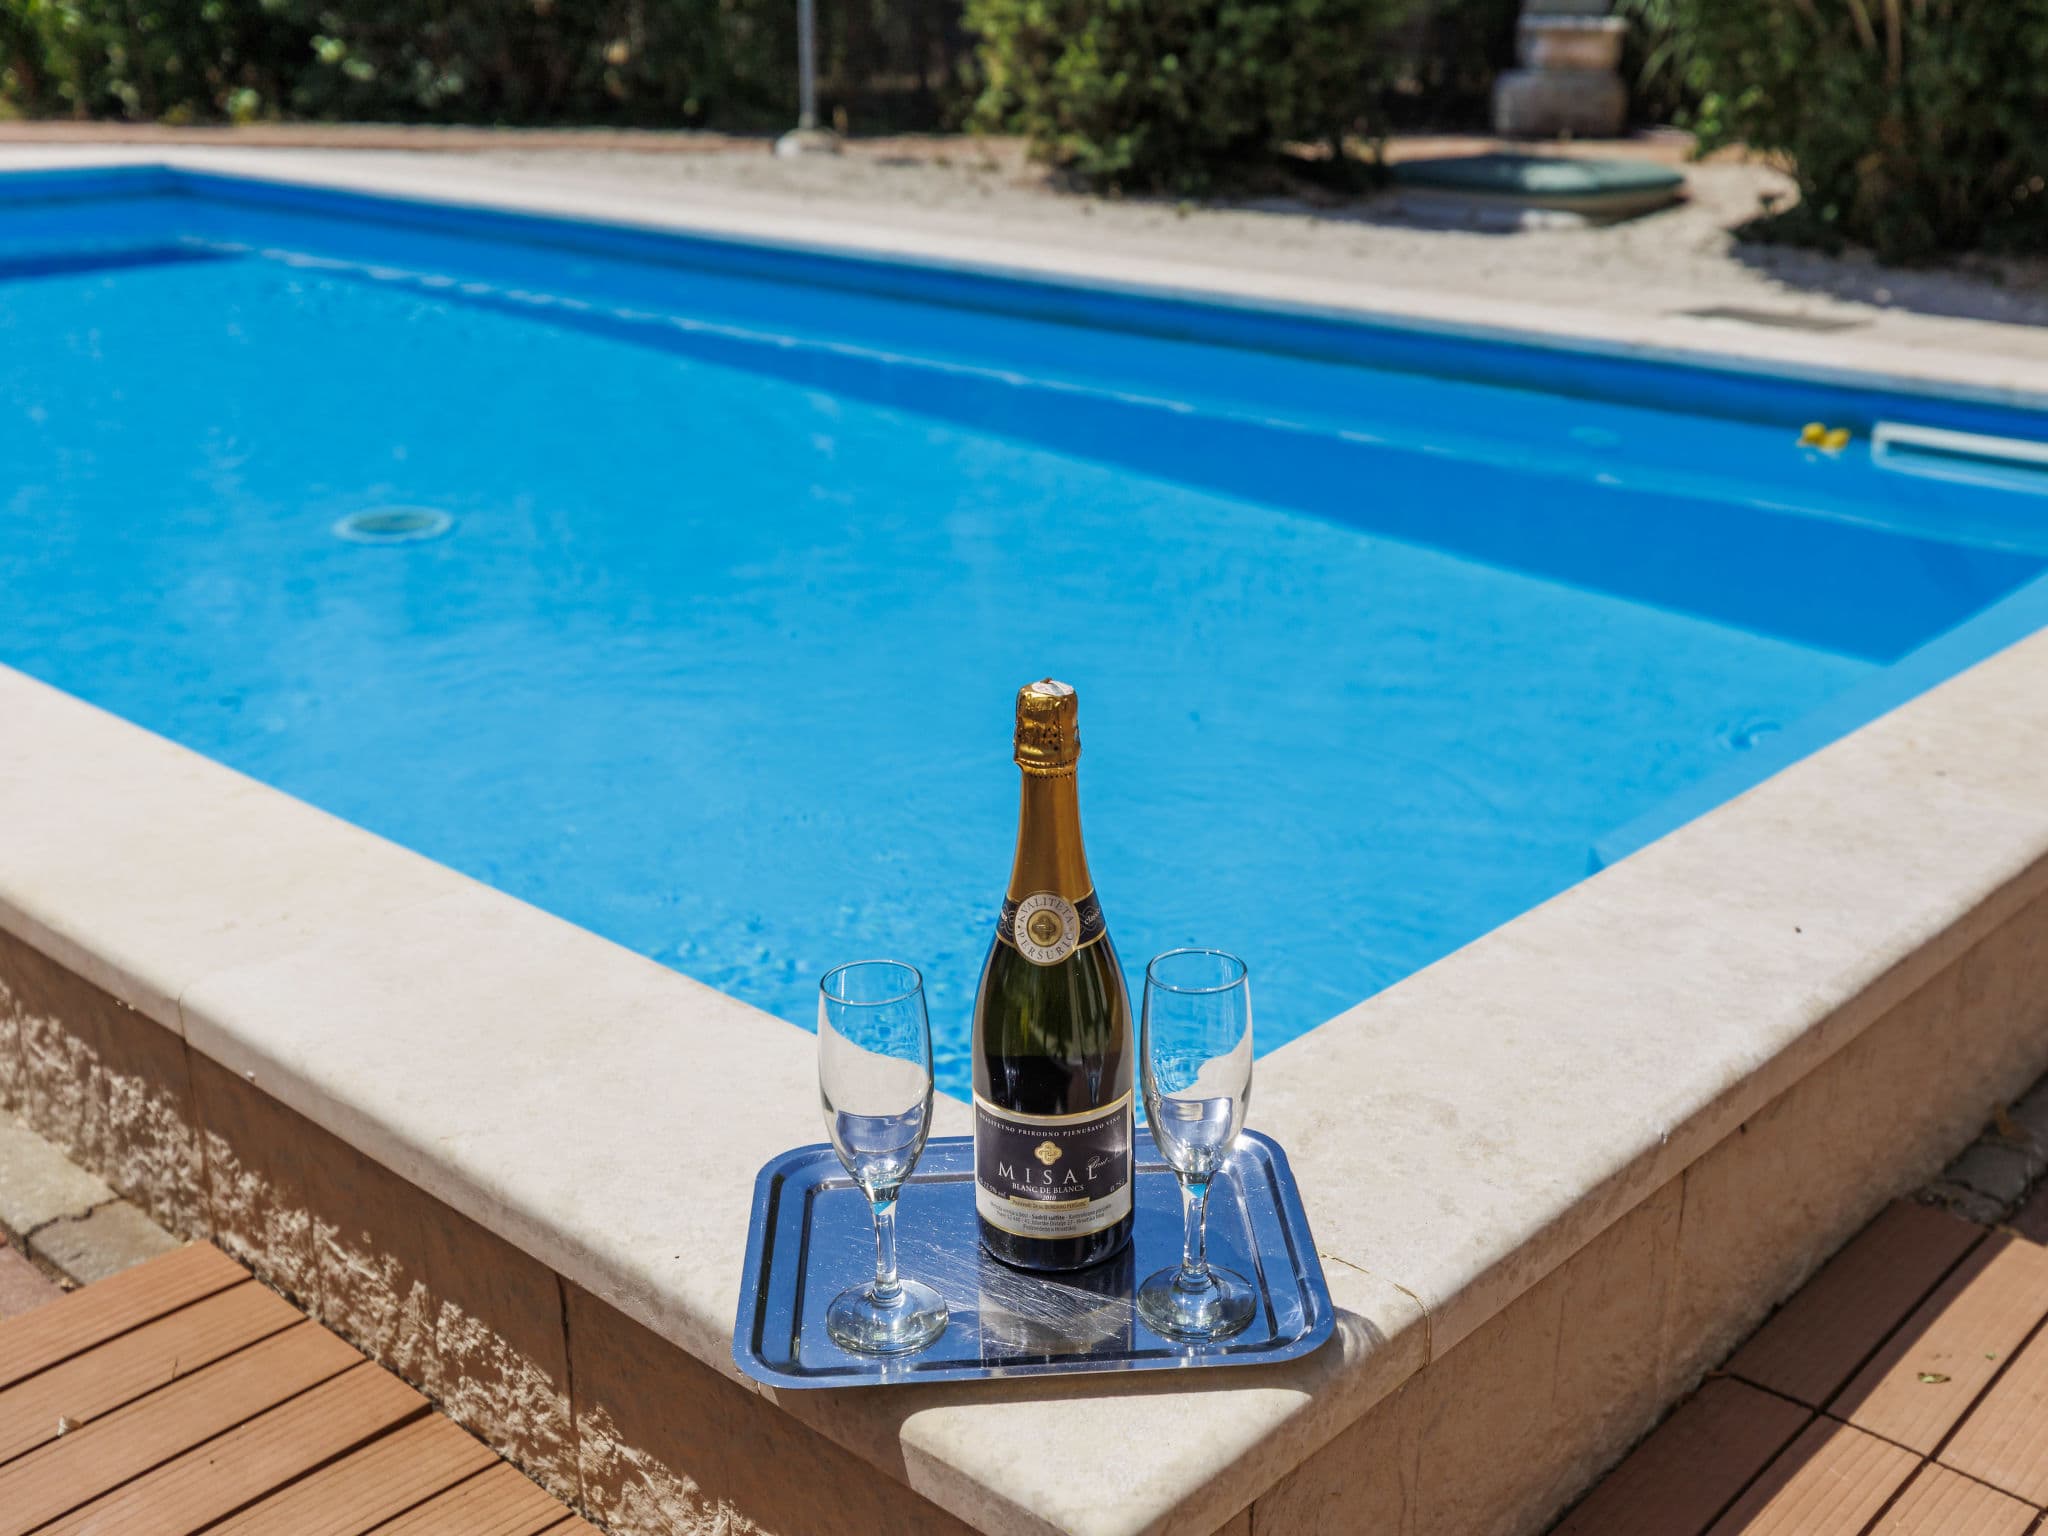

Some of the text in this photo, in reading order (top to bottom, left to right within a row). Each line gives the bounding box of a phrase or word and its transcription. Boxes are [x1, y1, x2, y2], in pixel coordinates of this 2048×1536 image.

[1018, 1128, 1060, 1137] PRIRODNO
[1063, 1122, 1104, 1137] PJENUŠAVO
[998, 1160, 1098, 1185] MISAL
[1012, 1184, 1085, 1194] BLANC DE BLANCS
